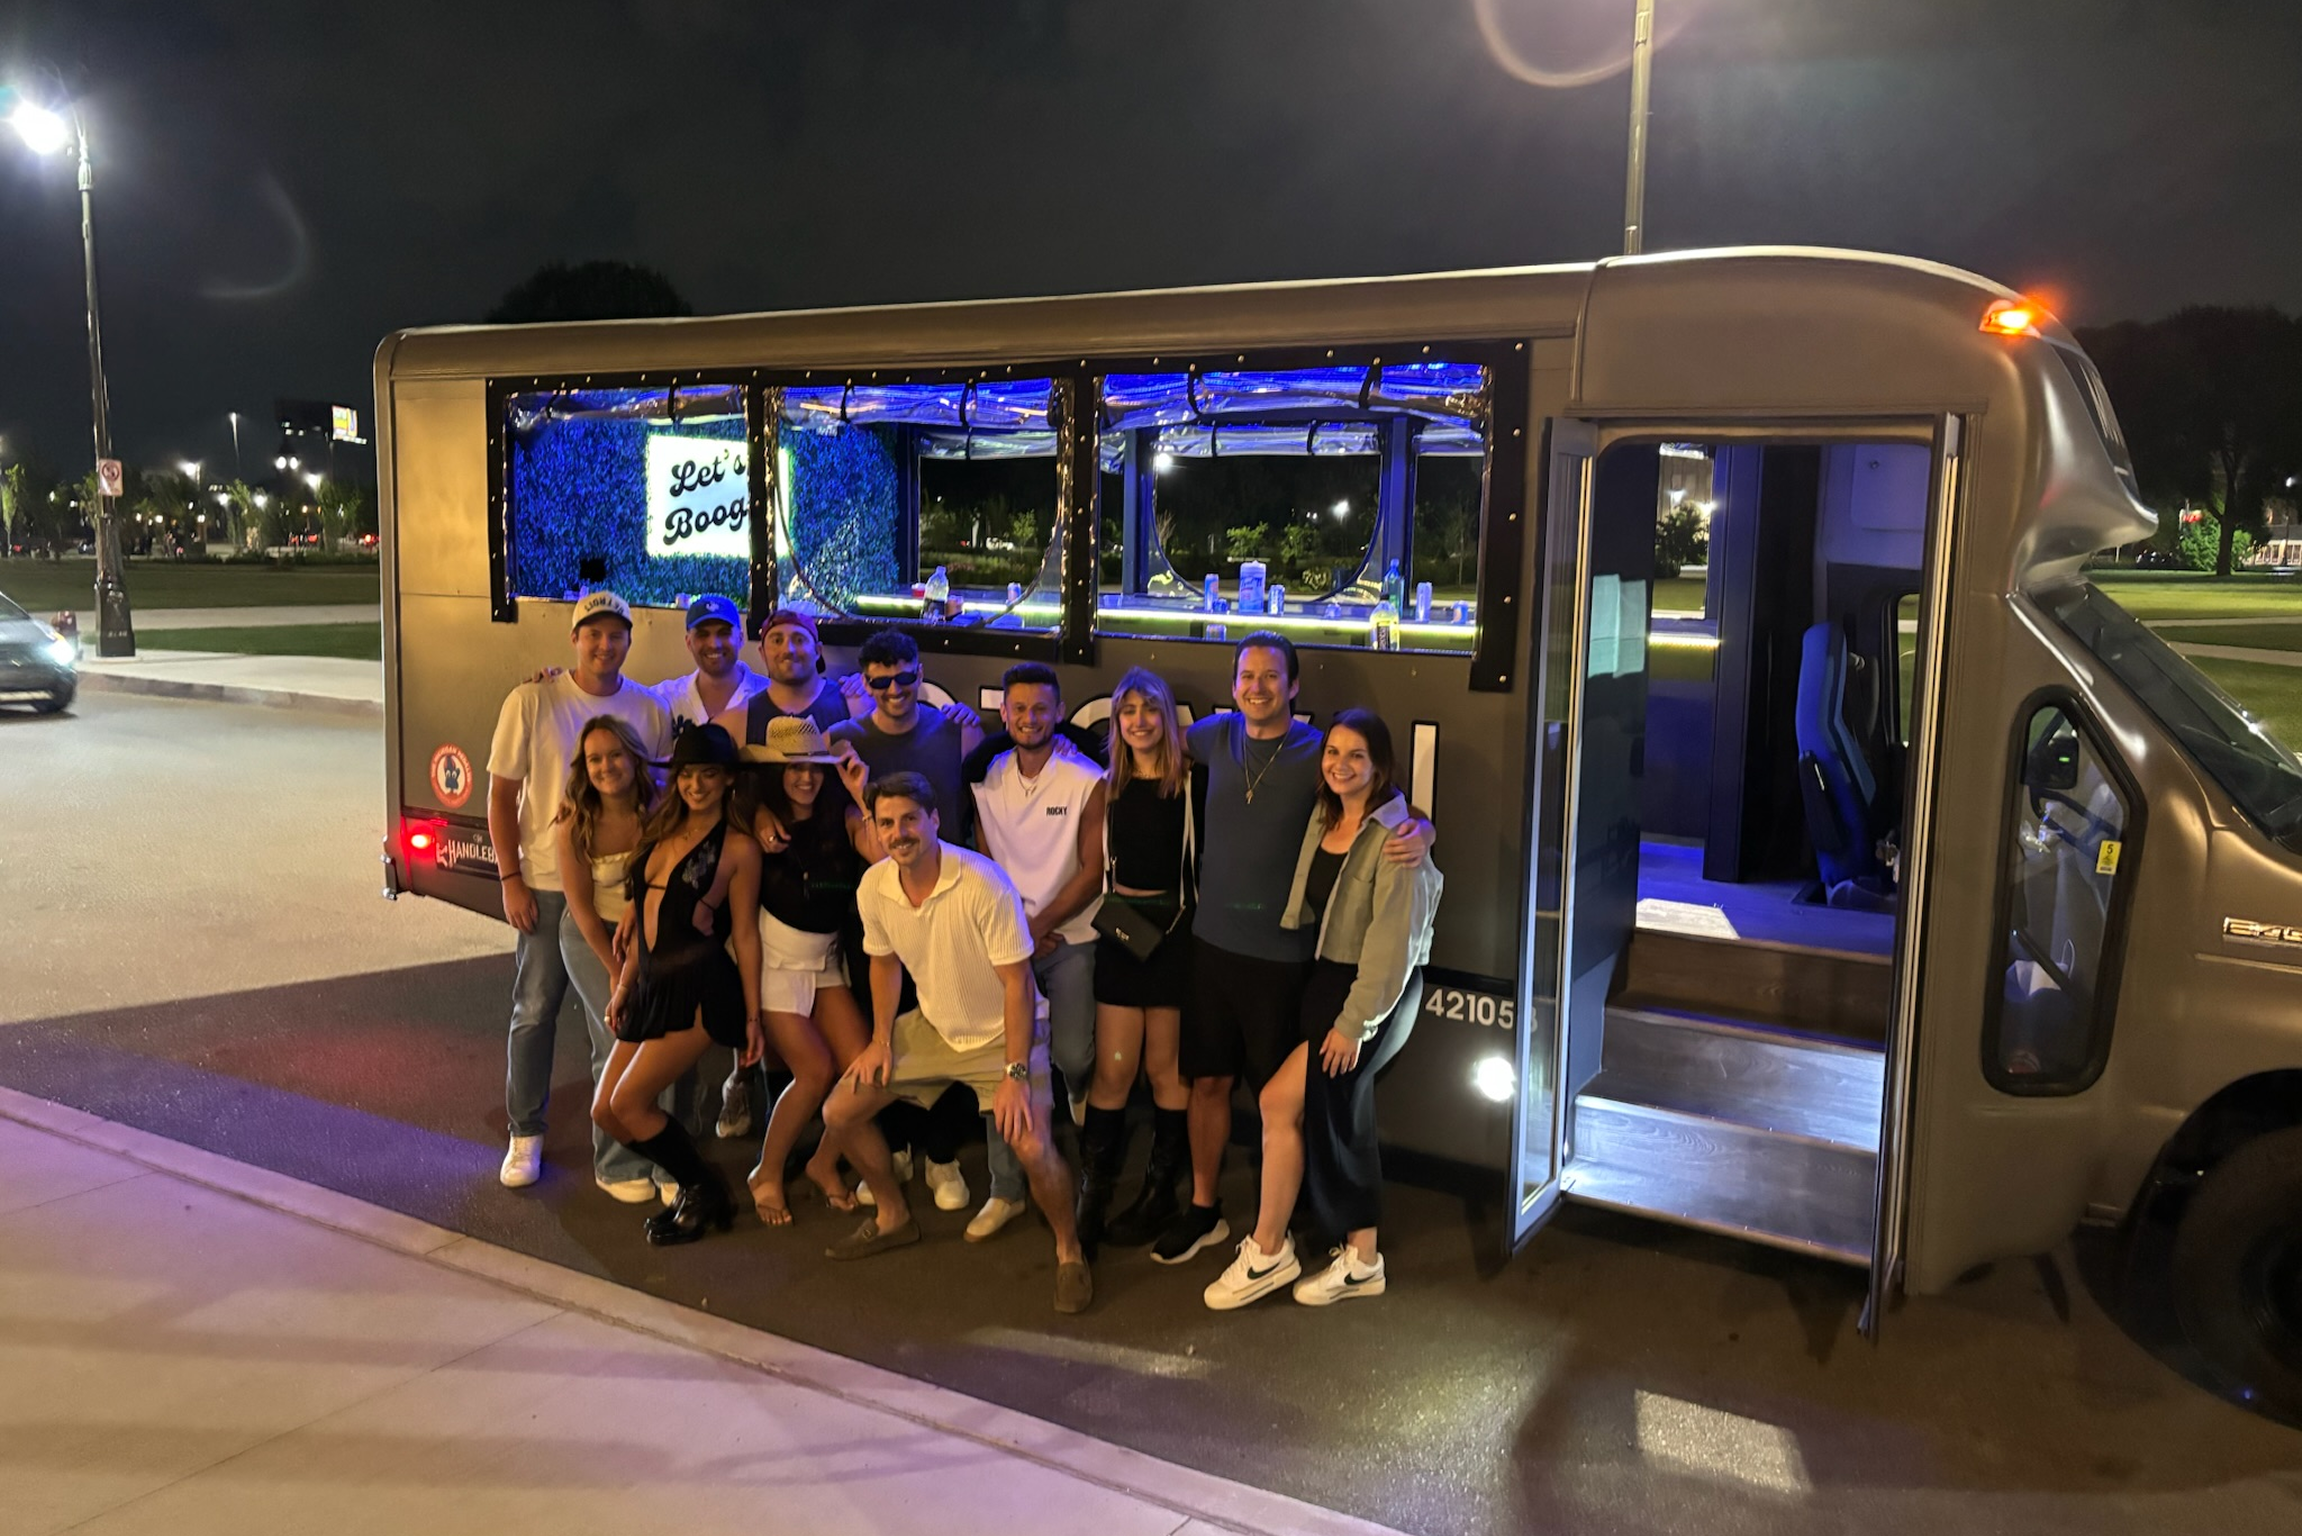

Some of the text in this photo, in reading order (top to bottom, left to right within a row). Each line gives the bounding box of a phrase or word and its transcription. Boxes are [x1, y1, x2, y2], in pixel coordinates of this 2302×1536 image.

[669, 448, 747, 497] Let's
[663, 496, 749, 546] Boog
[1046, 806, 1067, 816] ROCKY
[447, 839, 498, 866] HANDLEB
